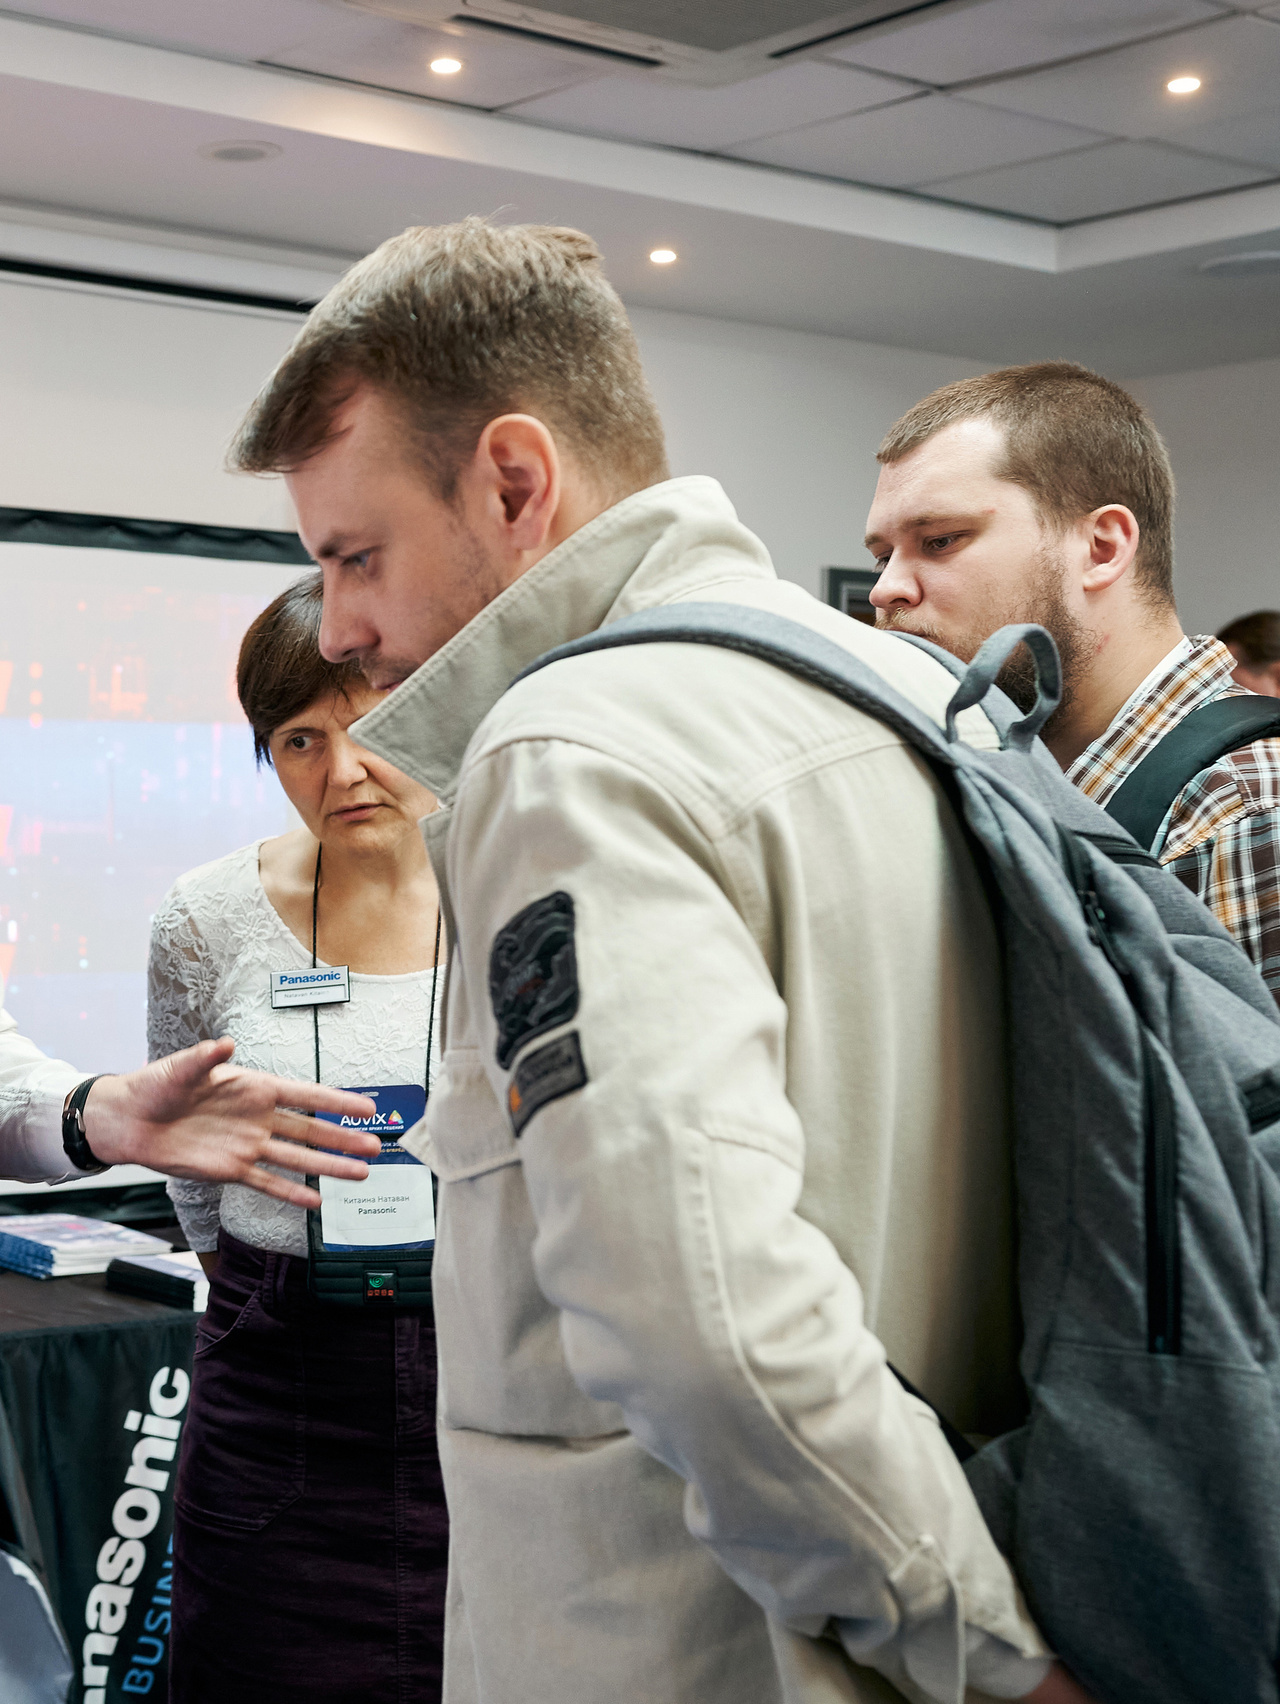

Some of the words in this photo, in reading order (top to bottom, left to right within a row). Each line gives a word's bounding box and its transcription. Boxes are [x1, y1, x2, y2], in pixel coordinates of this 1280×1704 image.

[279, 970, 341, 985] Panasonic
[340, 1113, 387, 1126] AUVIX
[377, 1195, 410, 1203] Натаван
[358, 1206, 397, 1215] Panasonic
